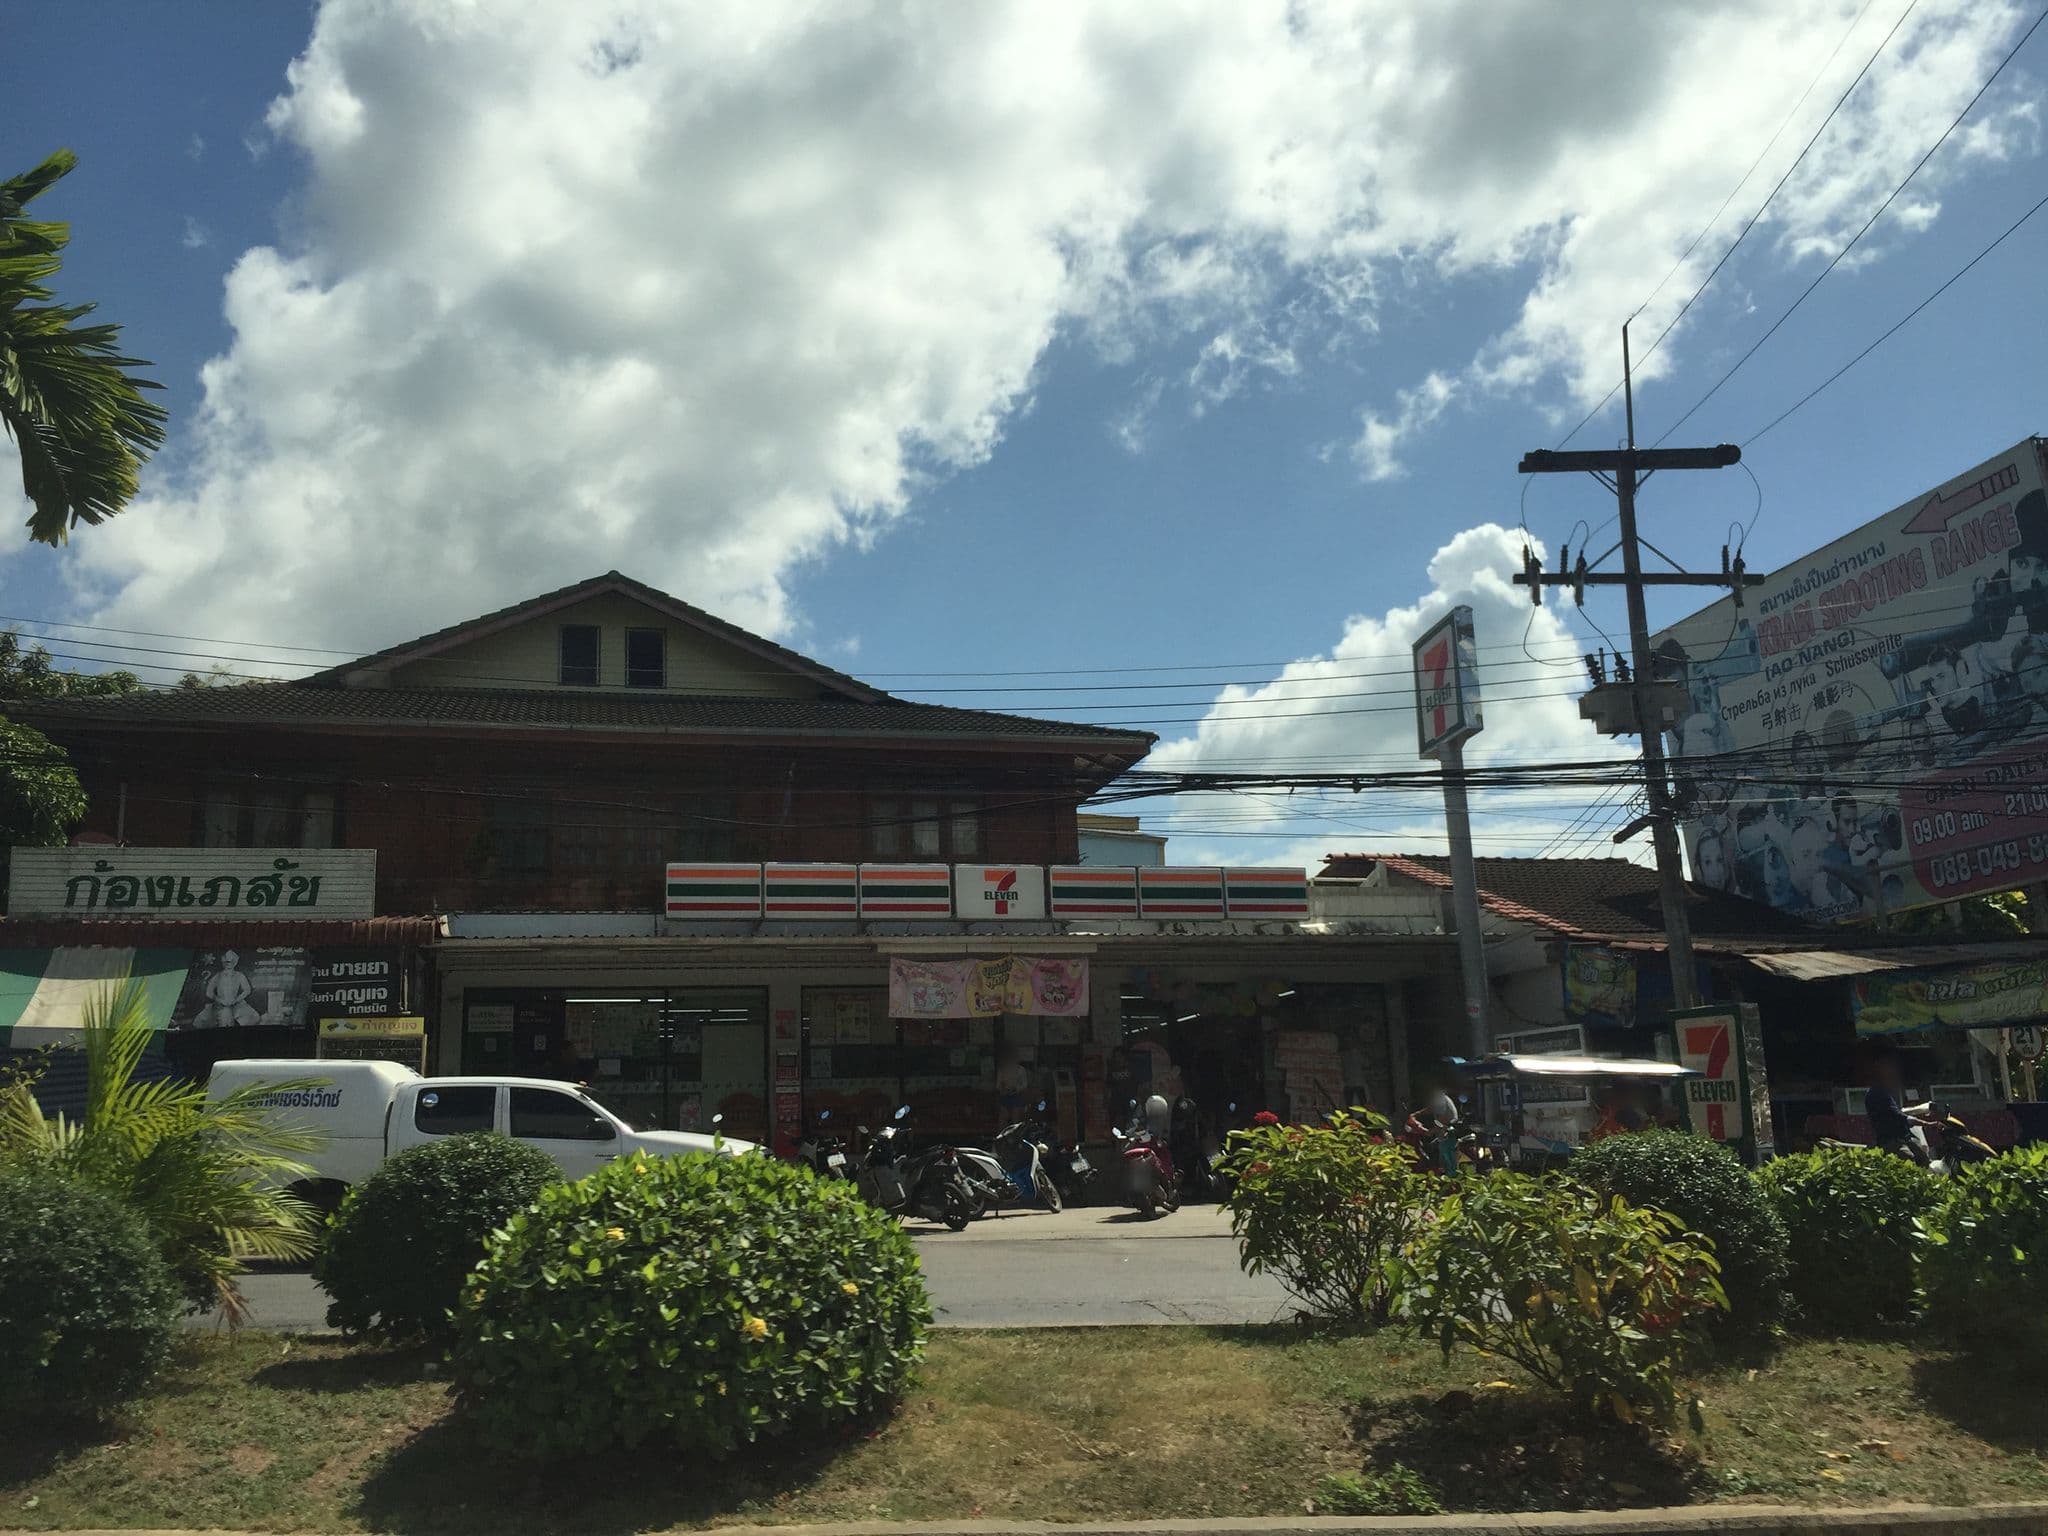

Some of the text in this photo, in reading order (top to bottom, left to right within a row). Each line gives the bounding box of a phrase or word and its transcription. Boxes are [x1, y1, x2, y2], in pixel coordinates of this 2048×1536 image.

[1757, 501, 2022, 658] KRABI SHOOTING RANGE
[1825, 632, 1903, 678] Schussweite
[1720, 671, 1817, 722] Стрельба из лука
[1912, 810, 1957, 846] 09.00
[1929, 833, 2048, 889] 088-049-8
[983, 869, 1017, 914] 7
[332, 961, 390, 977] ขายยา
[1685, 1022, 1731, 1141] 7
